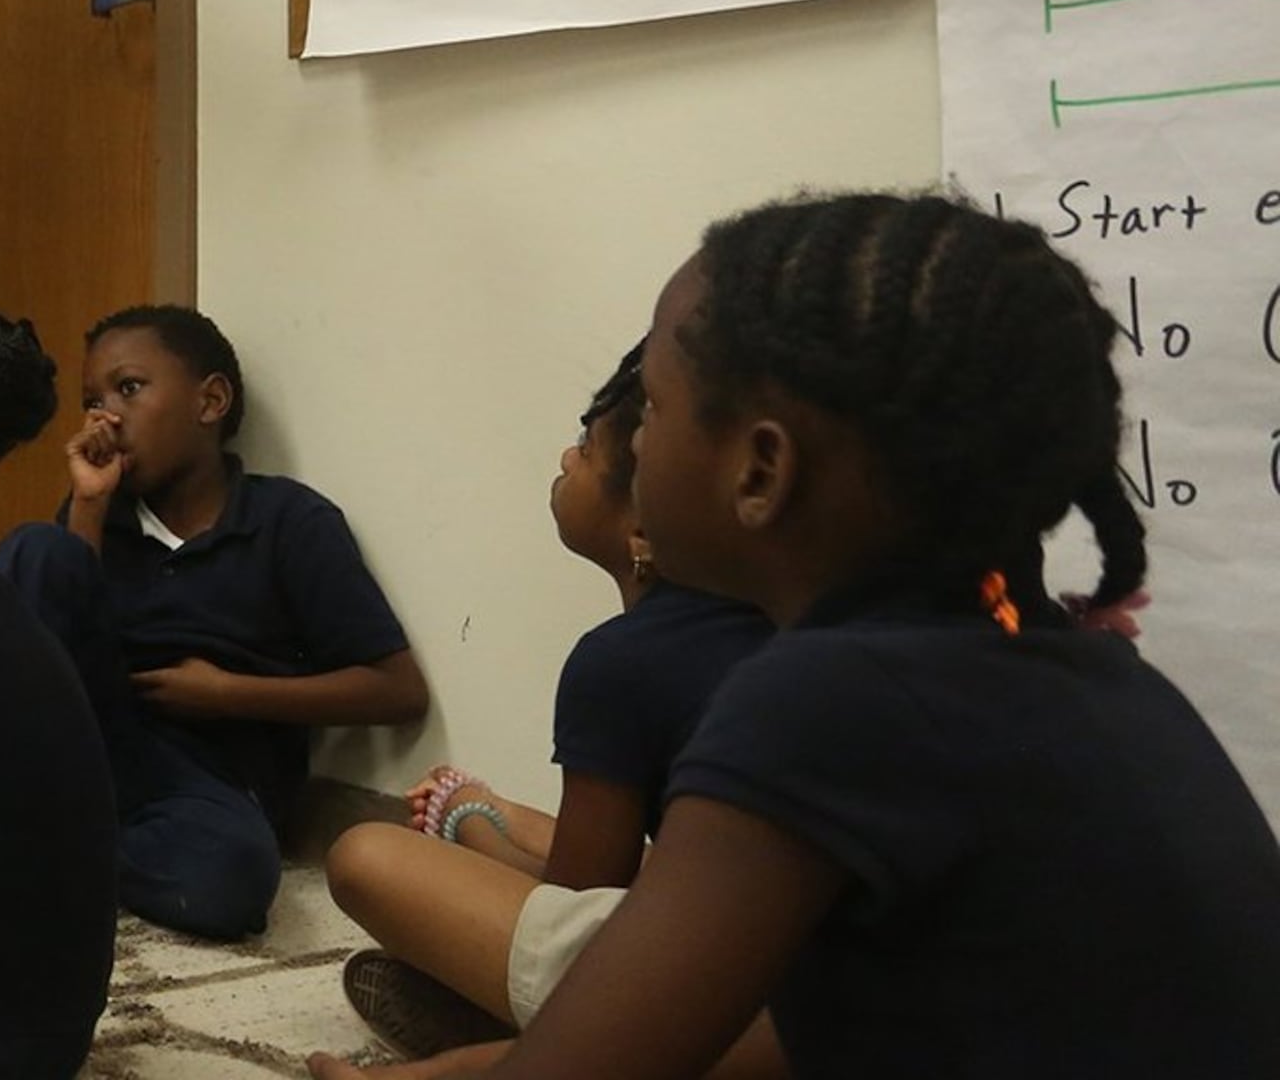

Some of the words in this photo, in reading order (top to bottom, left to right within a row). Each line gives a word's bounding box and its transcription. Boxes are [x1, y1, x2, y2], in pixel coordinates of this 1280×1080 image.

[1051, 180, 1207, 240] Start
[1112, 276, 1191, 357] No
[1116, 419, 1197, 509] No
